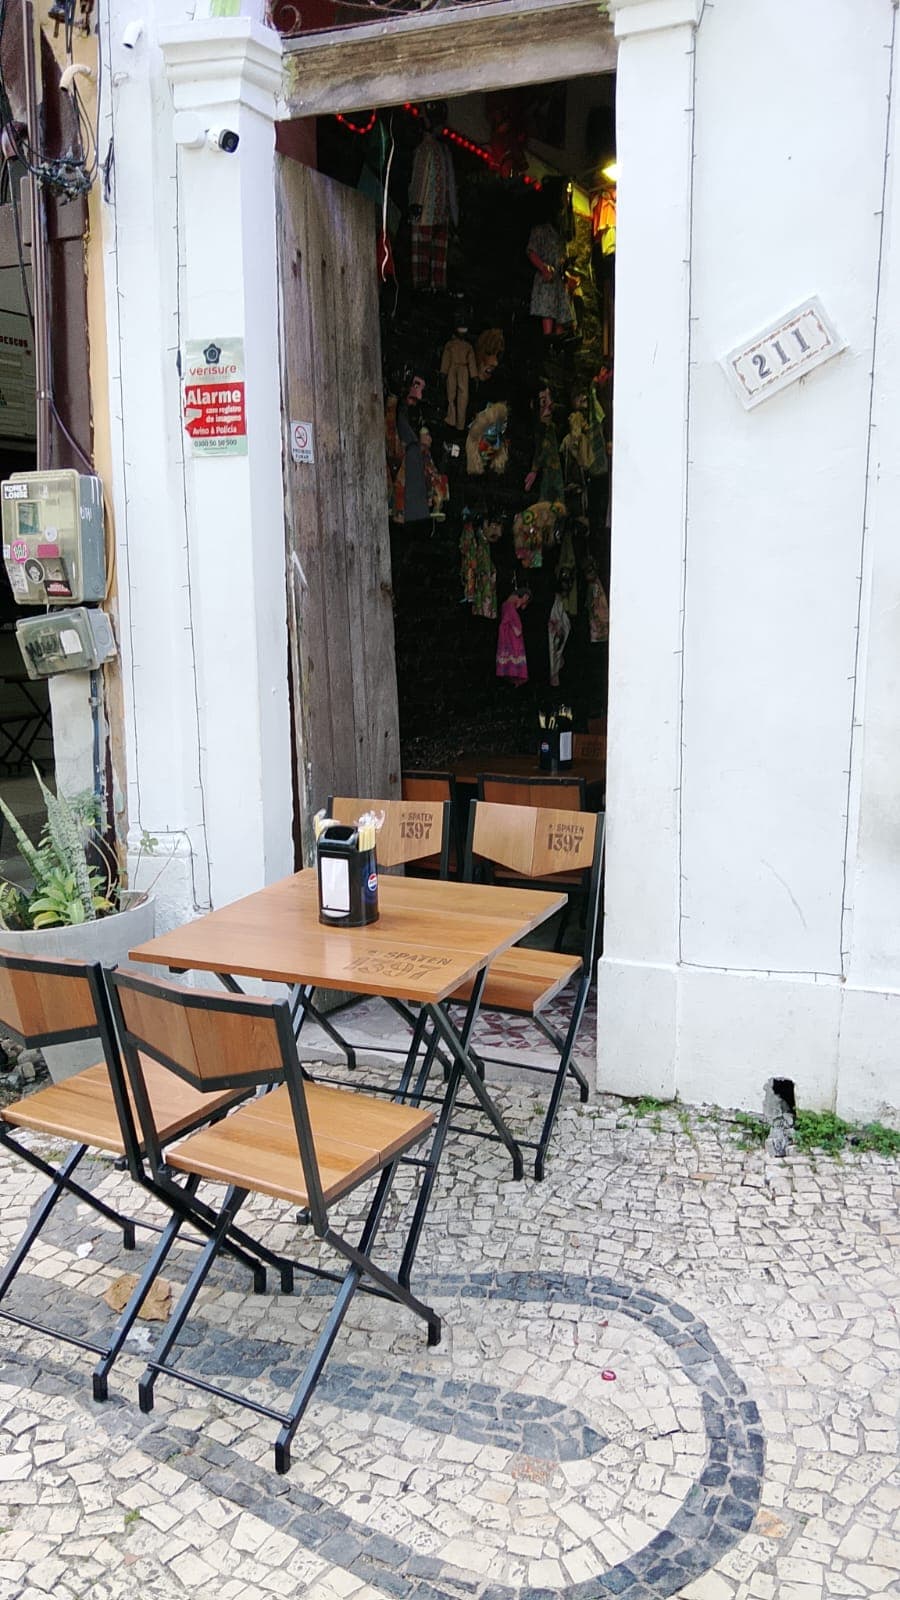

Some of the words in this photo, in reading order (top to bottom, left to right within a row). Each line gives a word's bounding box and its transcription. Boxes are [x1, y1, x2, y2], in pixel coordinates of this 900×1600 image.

[752, 328, 810, 379] 211
[189, 365, 237, 376] verisure
[187, 388, 242, 406] Alarme
[206, 415, 214, 423] de
[408, 812, 433, 822] SPATEN
[400, 821, 433, 840] 1397
[556, 823, 584, 834] SPATEN
[547, 833, 584, 853] 1397
[384, 951, 453, 966] SPATEN
[343, 957, 442, 980] 1397
